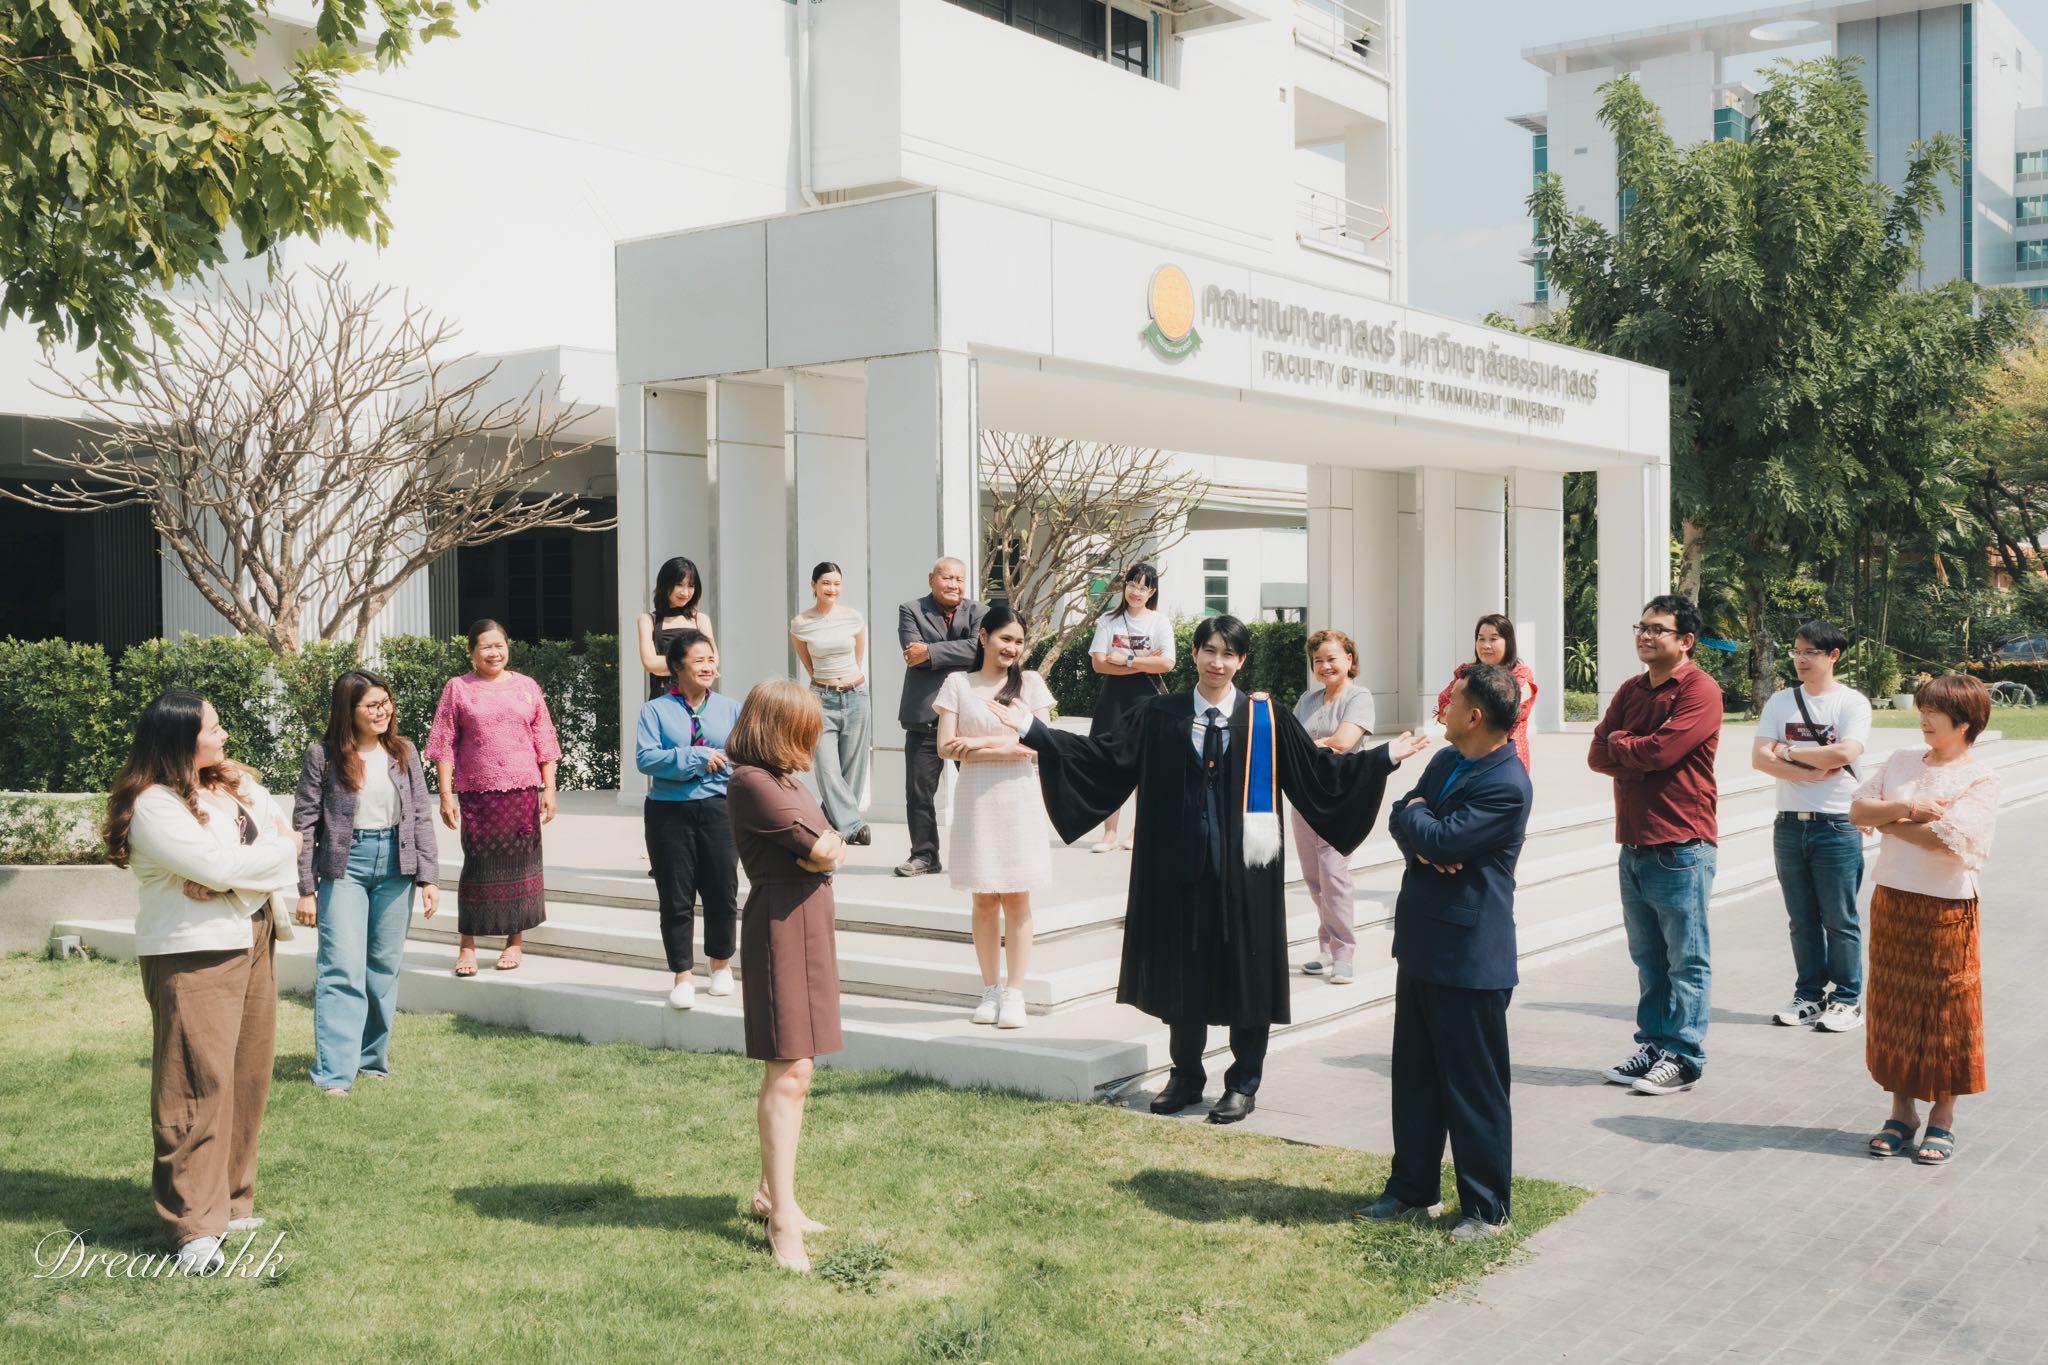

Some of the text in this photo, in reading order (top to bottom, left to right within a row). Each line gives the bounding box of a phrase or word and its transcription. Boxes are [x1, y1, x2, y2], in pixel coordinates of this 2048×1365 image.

[1203, 284, 1599, 401] คณะแพทยศาสตร์ มหาวิทยาลัยธรรมศาสตร์
[1264, 351, 1566, 425] FACULTY OF MEDICINE THAMMASAT UNIVERSITY
